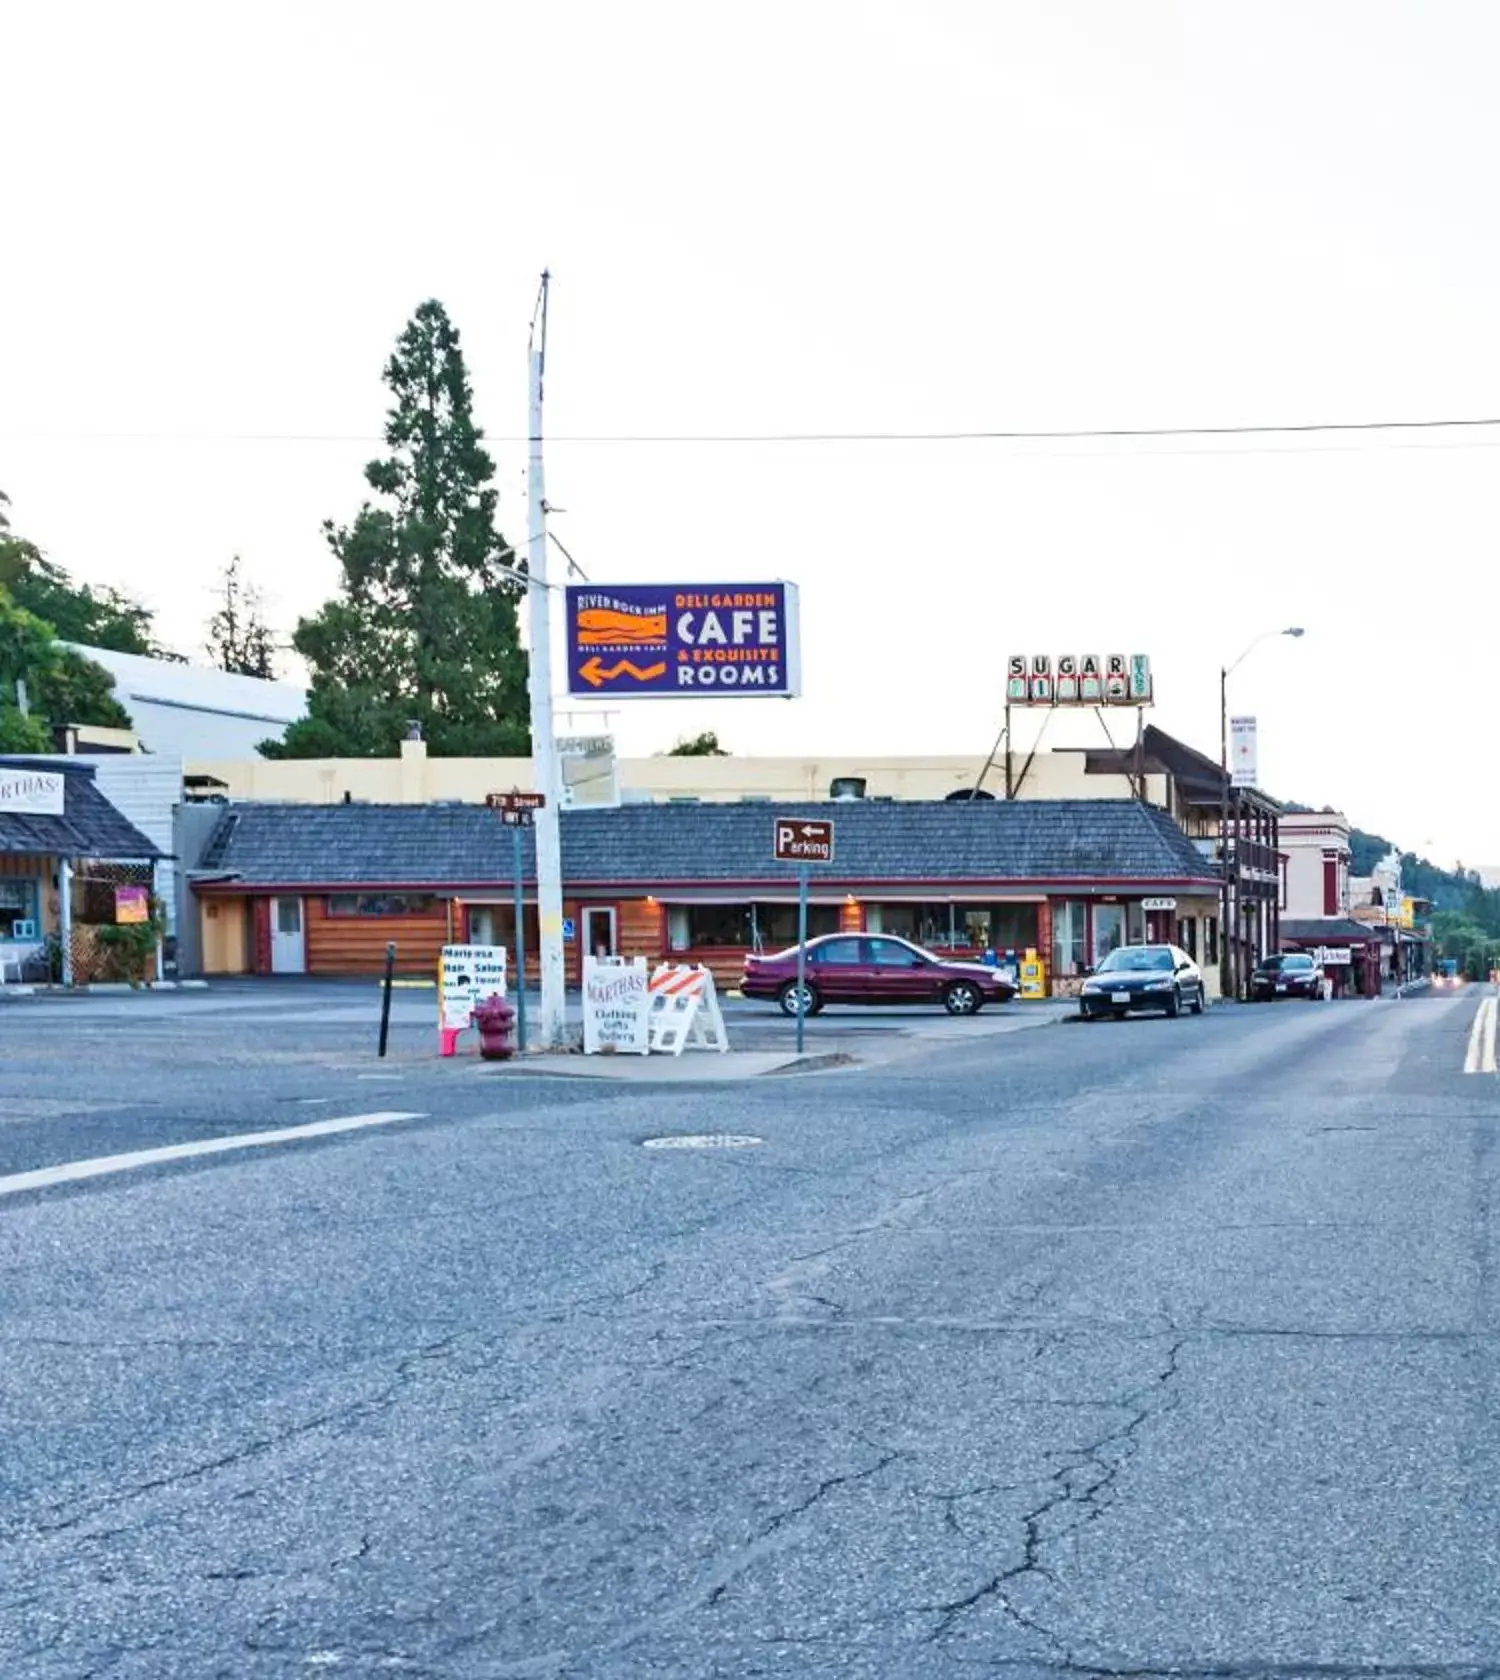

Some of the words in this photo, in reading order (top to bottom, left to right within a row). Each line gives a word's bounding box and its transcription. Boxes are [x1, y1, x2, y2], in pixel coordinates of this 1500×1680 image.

[577, 593, 610, 611] RIVER
[613, 598, 642, 615] ROCK
[677, 611, 777, 644] CAFE
[693, 648, 779, 661] EXQUISITE
[1010, 657, 1121, 673] SUGAR
[677, 664, 779, 684] ROOMS
[779, 827, 829, 858] Parking
